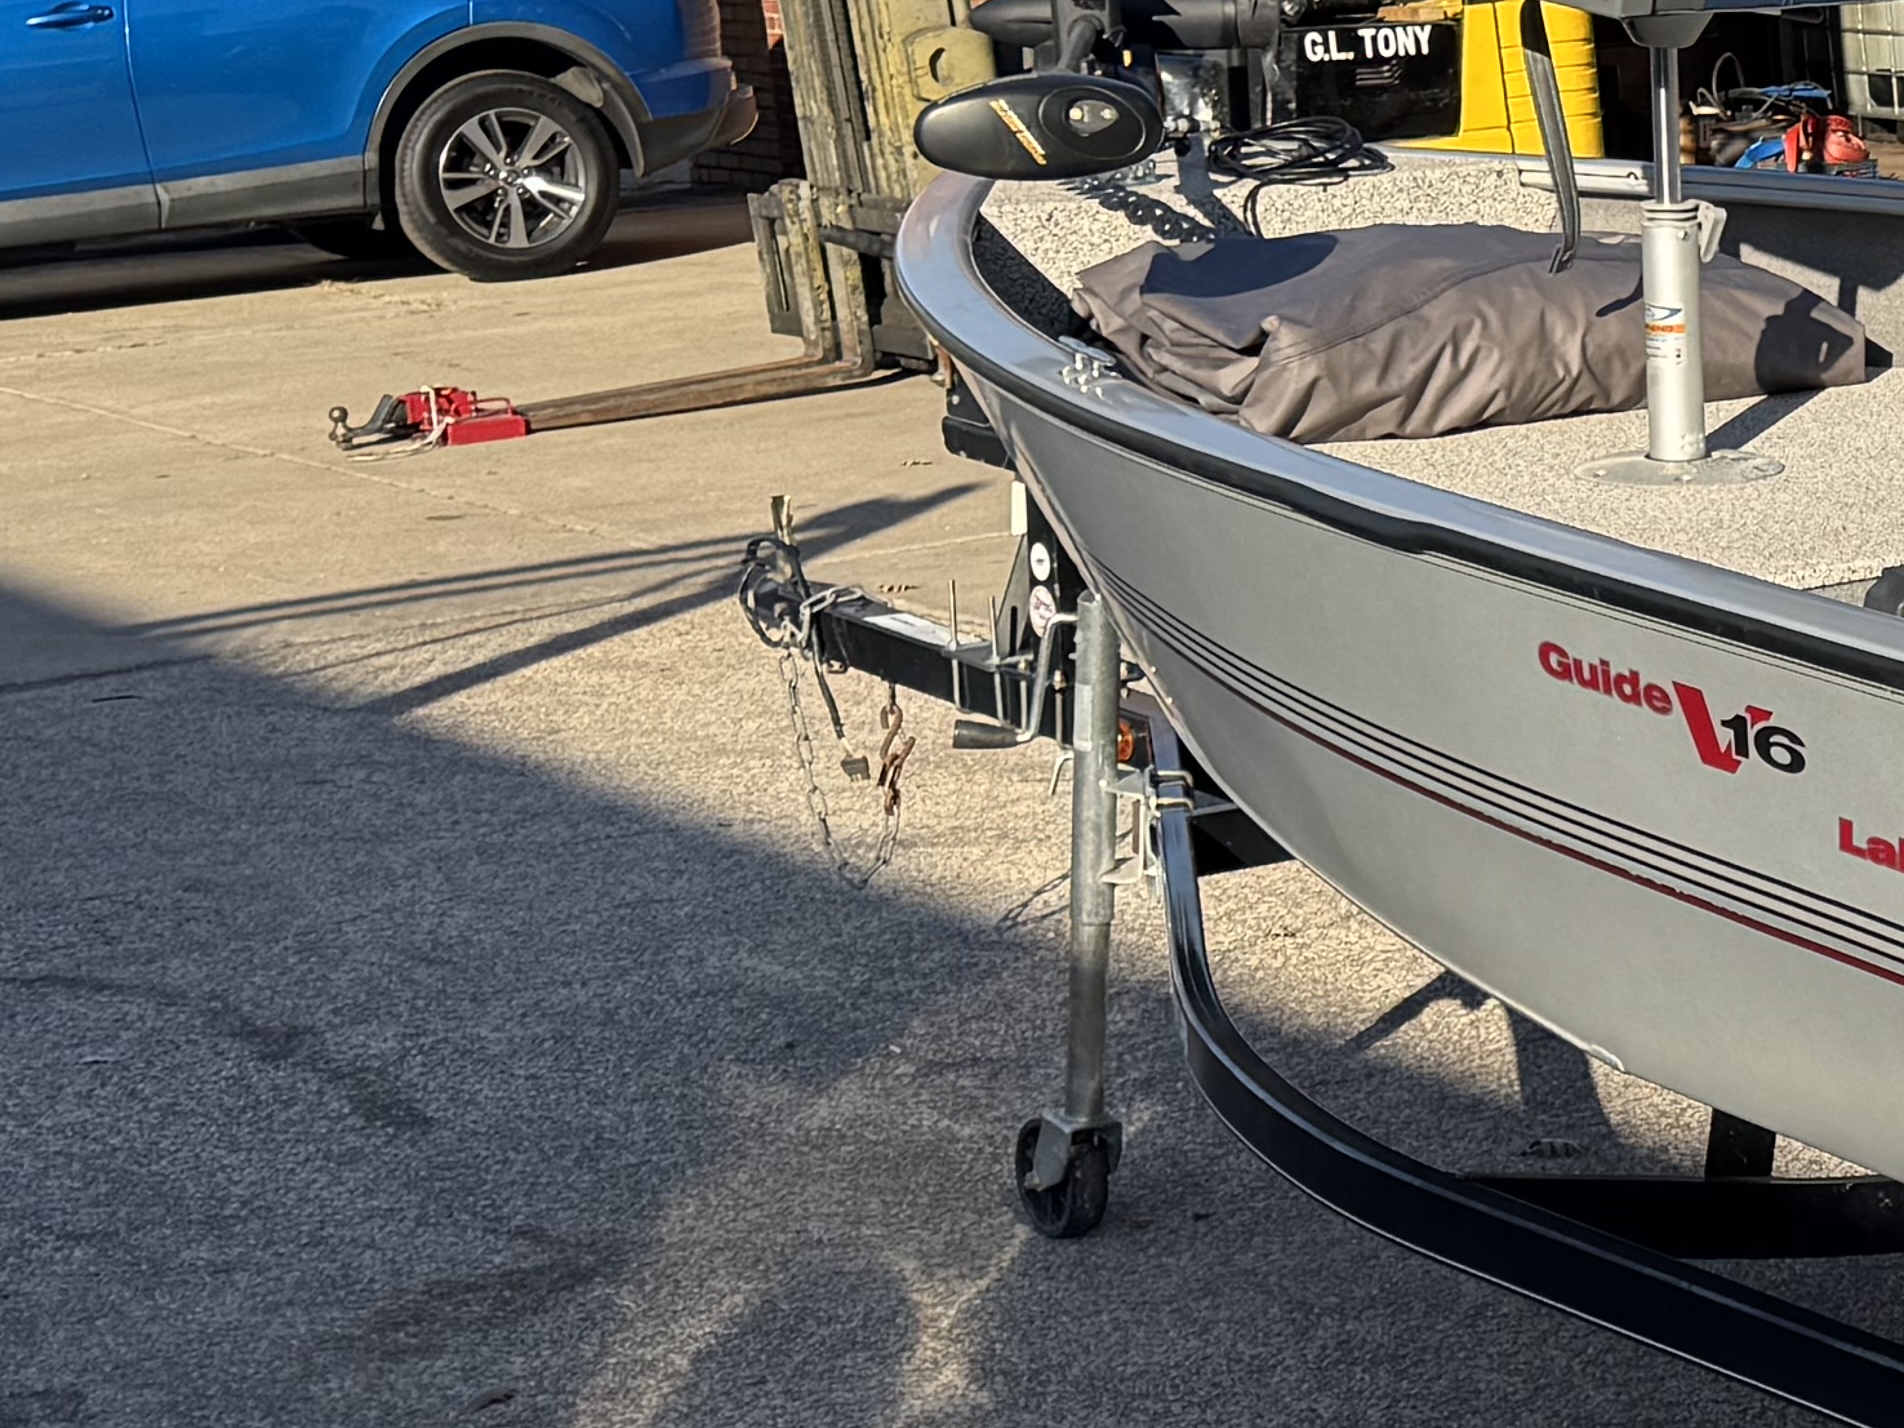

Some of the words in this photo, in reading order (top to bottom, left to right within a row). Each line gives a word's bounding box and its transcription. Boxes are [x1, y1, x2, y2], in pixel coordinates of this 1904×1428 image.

[1304, 30, 1355, 62] G.L.
[1357, 24, 1432, 59] TONY
[1537, 641, 1674, 716] Guide
